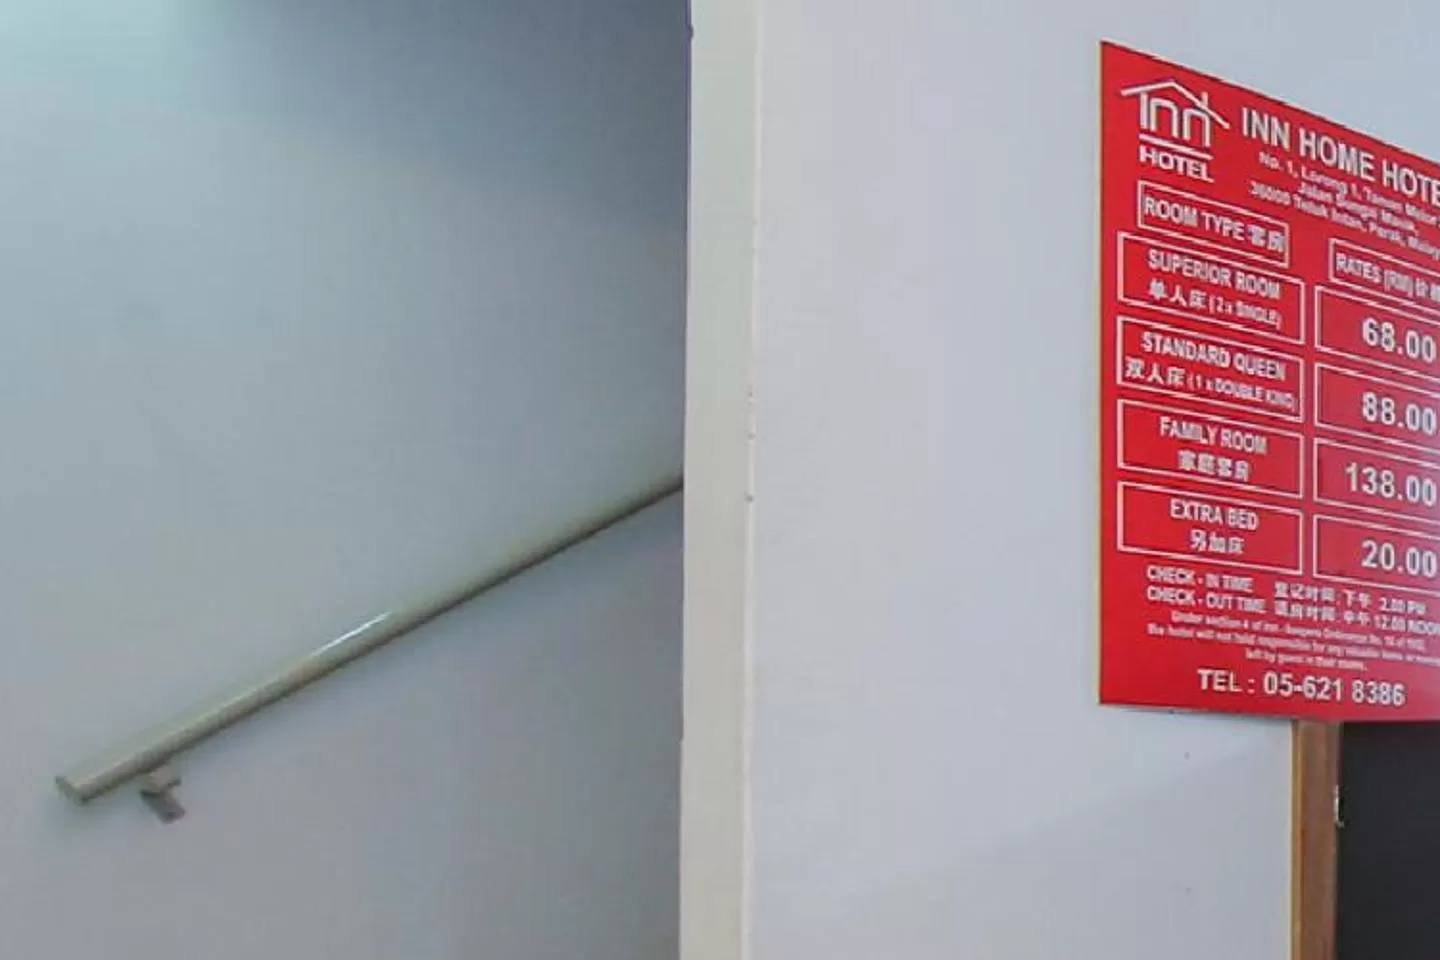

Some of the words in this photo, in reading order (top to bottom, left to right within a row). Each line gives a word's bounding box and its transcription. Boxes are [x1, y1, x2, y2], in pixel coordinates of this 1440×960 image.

[1139, 144, 1215, 184] HOTEL
[1242, 107, 1289, 149] INN
[1299, 128, 1375, 181] HOME
[1144, 195, 1197, 227] ROOM
[1201, 212, 1244, 240] TYPE
[1147, 248, 1232, 288] SUPERIOR
[1235, 272, 1279, 300] ROOM
[1335, 252, 1380, 282] RATES
[1142, 330, 1229, 369] STANDARD
[1233, 352, 1285, 381] QUEEN
[1362, 315, 1436, 364] 68.00
[1159, 416, 1218, 444] FAMILY
[1221, 428, 1267, 453] ROOM
[1362, 390, 1436, 436] 88.00
[1345, 461, 1436, 506] 138.00
[1170, 499, 1222, 524] EXTRA
[1226, 509, 1258, 529] BED
[1360, 539, 1437, 578] 20.00
[1147, 565, 1195, 585] CHECK
[1223, 575, 1253, 592] TIME
[1407, 600, 1425, 614] PM
[1147, 586, 1195, 603] CHECK
[1206, 593, 1232, 608] OUT
[1238, 597, 1267, 612] TIME
[1197, 668, 1242, 690] TEL
[1264, 671, 1342, 699] 05-621
[1351, 680, 1405, 705] 8386
